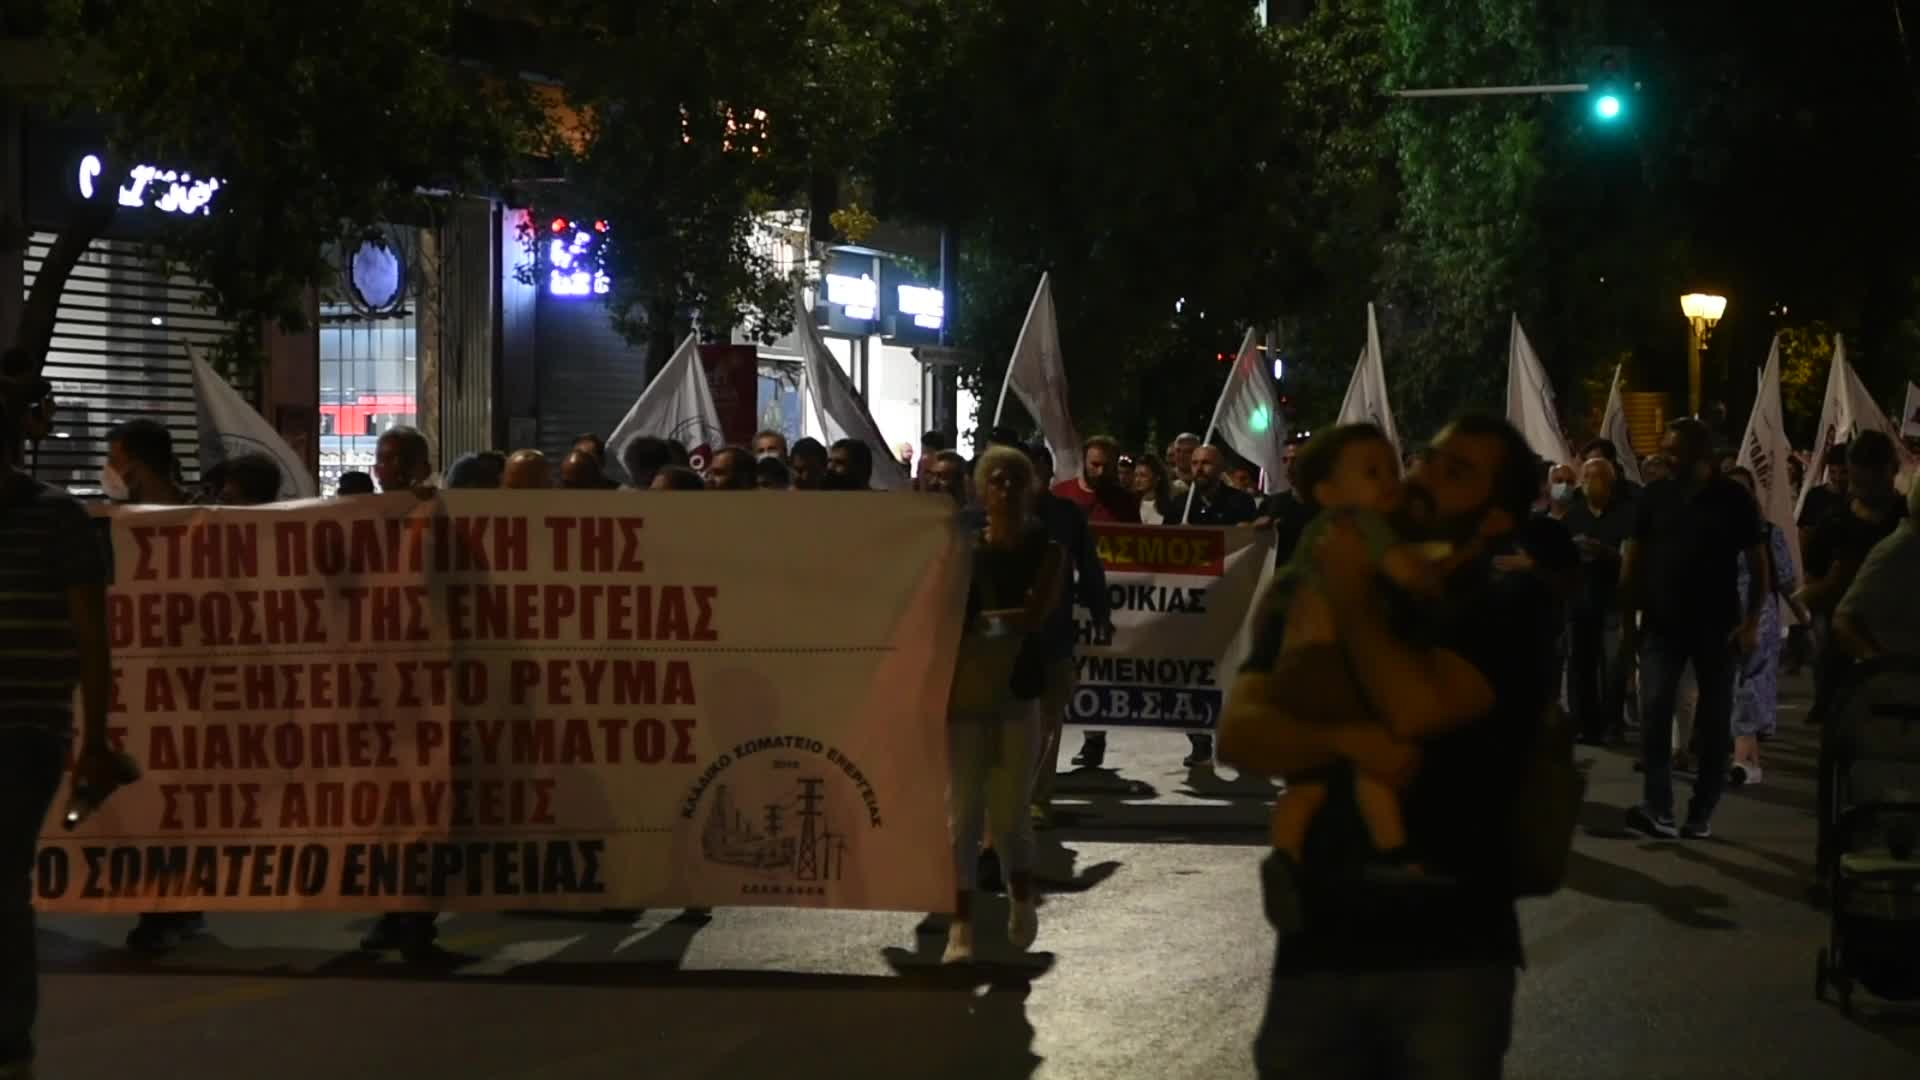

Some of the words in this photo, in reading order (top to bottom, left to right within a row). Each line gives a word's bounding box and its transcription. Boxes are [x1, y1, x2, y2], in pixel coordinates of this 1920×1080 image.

[131, 523, 258, 580] ΣΤΗΝ
[275, 516, 528, 577] ΠΟΛΙΤΙΚΗ
[544, 516, 645, 573] ΤΗΣ
[340, 585, 432, 643] ΤΗΣ
[447, 584, 719, 642] ΕΝΕΡΓΕΙΑΣ
[144, 661, 380, 711] ΑΥΞΗΣΕΙΣ
[396, 659, 488, 707] ΣΤΟ
[511, 660, 697, 706] ΡΕΥΜΑ
[149, 721, 398, 770] ΔΙΑΚΟΠΕΣ
[415, 718, 697, 768] ΡΕΥΜΑΤΟΣ
[159, 783, 262, 830] ΣΤΙΣ
[279, 779, 556, 829] ΑΠΟΛΥΣΕΙΣ
[80, 843, 330, 899] ΣΩΜΑΤΕΙΟ
[340, 839, 605, 897] ΕΝΕΡΓΕΙΑΣ
